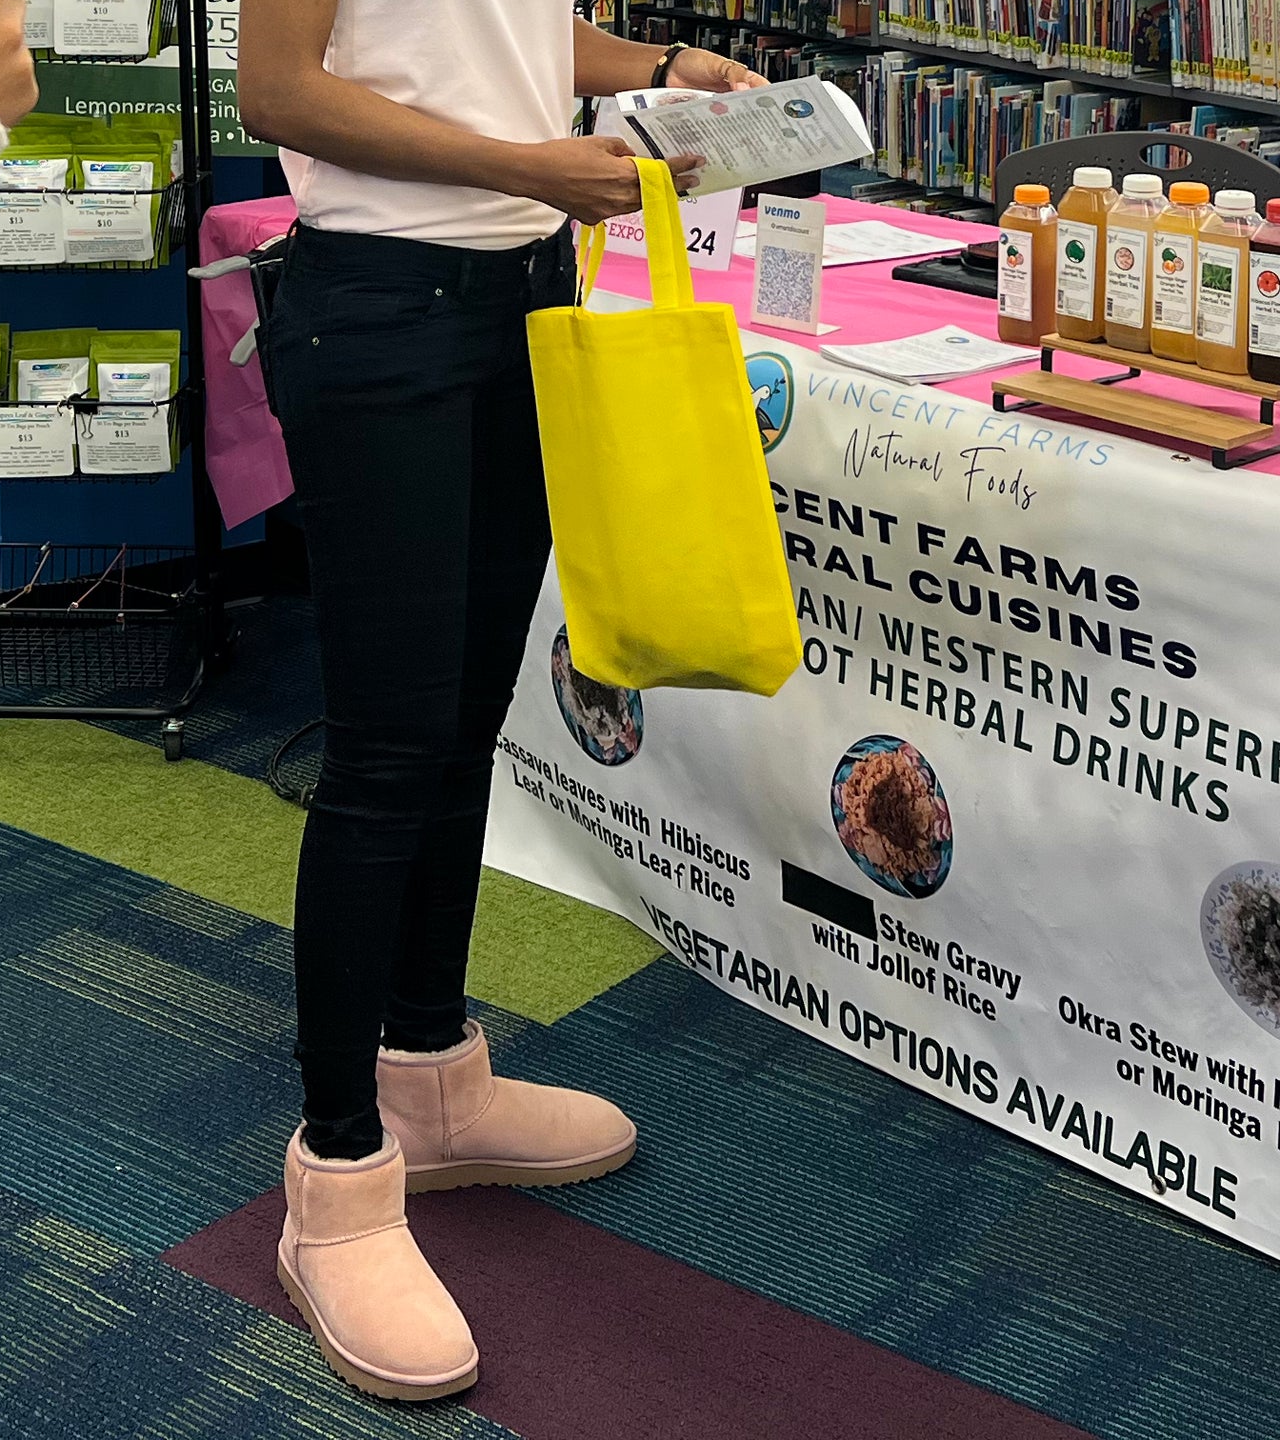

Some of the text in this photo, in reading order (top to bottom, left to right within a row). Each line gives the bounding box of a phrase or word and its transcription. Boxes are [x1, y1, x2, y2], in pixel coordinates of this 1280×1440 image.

[93, 7, 108, 15] $10
[97, 218, 112, 228] $10
[608, 223, 716, 256] EXPO 24
[764, 205, 800, 220] venmo
[18, 434, 33, 443] $13
[114, 430, 129, 439] $13
[807, 371, 1115, 467] VINCENT FARMS
[843, 424, 1039, 511] Natural Foods
[771, 481, 1141, 611] CENT FARMS
[784, 530, 1198, 679] RAL CUISINES
[797, 586, 862, 641] AN/
[878, 612, 1089, 716] WESTERN
[803, 637, 1231, 823] OT HERBAL DRINKS
[512, 762, 735, 908] Leaf or Moringa Leaf Rice
[554, 762, 606, 813] leaves
[609, 799, 650, 836] with
[660, 818, 751, 881] Hibiscus
[812, 922, 997, 1022] with Jollof Rice
[880, 912, 1022, 1000] Stew Gravy
[639, 895, 1240, 1220] VEGETARIAN OPTIONS AVAILABLE
[1057, 994, 1121, 1044] Okra
[1128, 1021, 1199, 1072] Stew
[1205, 1055, 1266, 1102] with
[1116, 1059, 1145, 1087] or
[1152, 1068, 1262, 1141] Moringa
